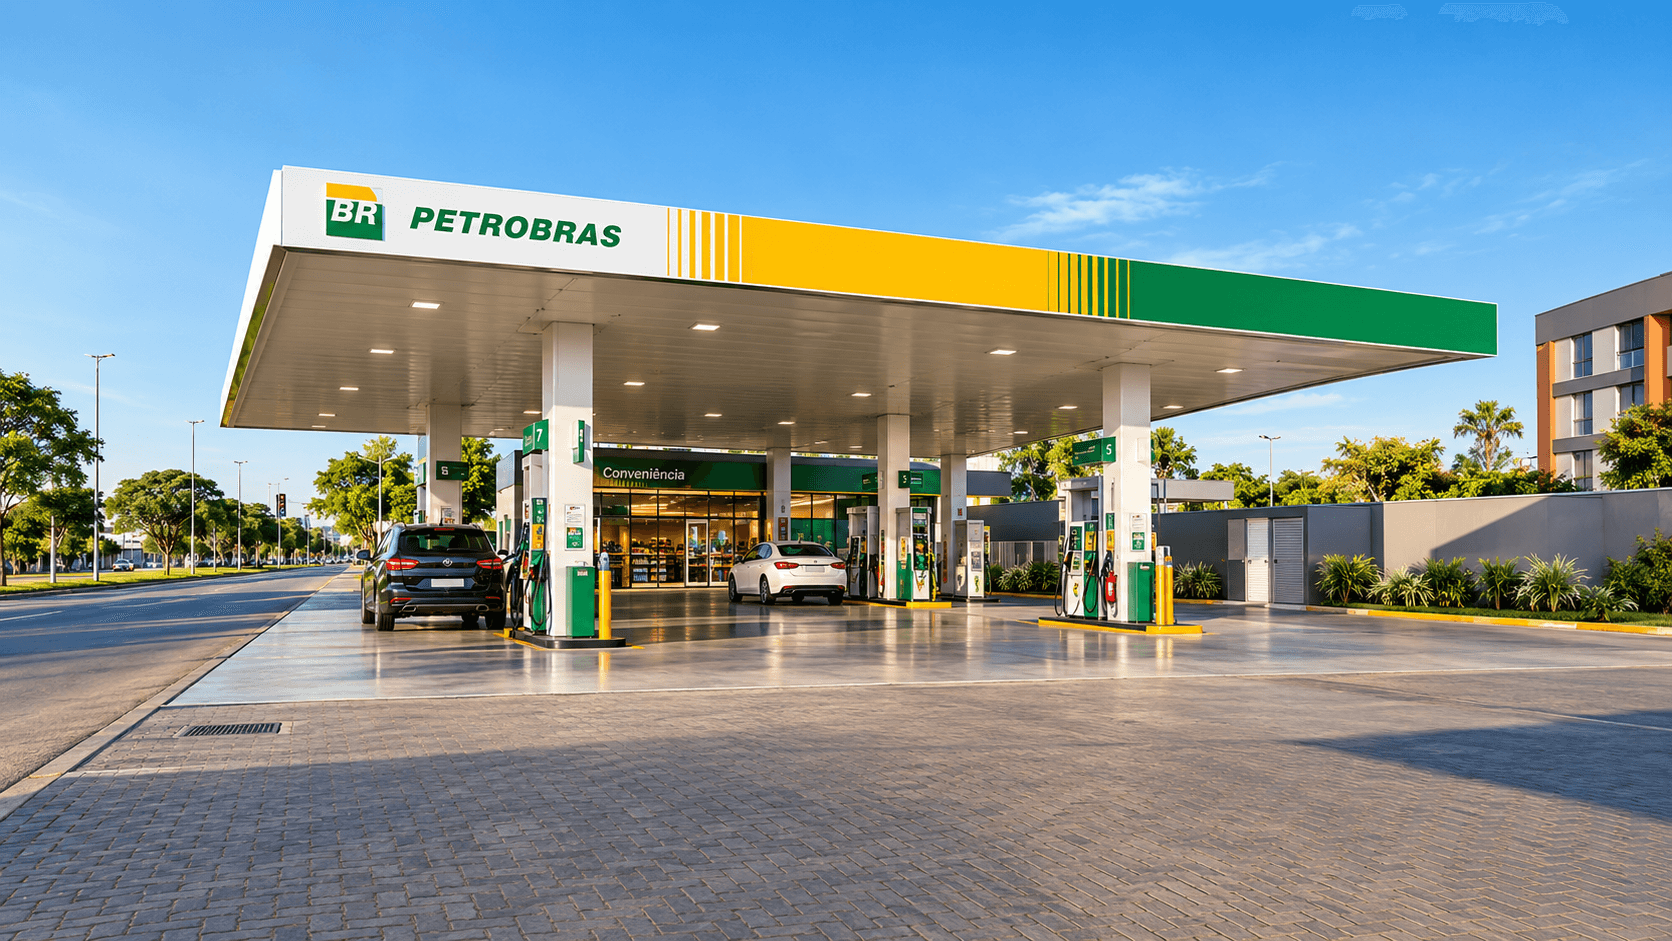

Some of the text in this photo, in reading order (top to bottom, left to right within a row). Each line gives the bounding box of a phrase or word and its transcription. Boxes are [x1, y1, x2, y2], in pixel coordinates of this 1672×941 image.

[330, 199, 378, 226] BR
[409, 206, 622, 248] PETROBRAS
[536, 428, 543, 442] 7
[603, 466, 685, 480] Conveniência
